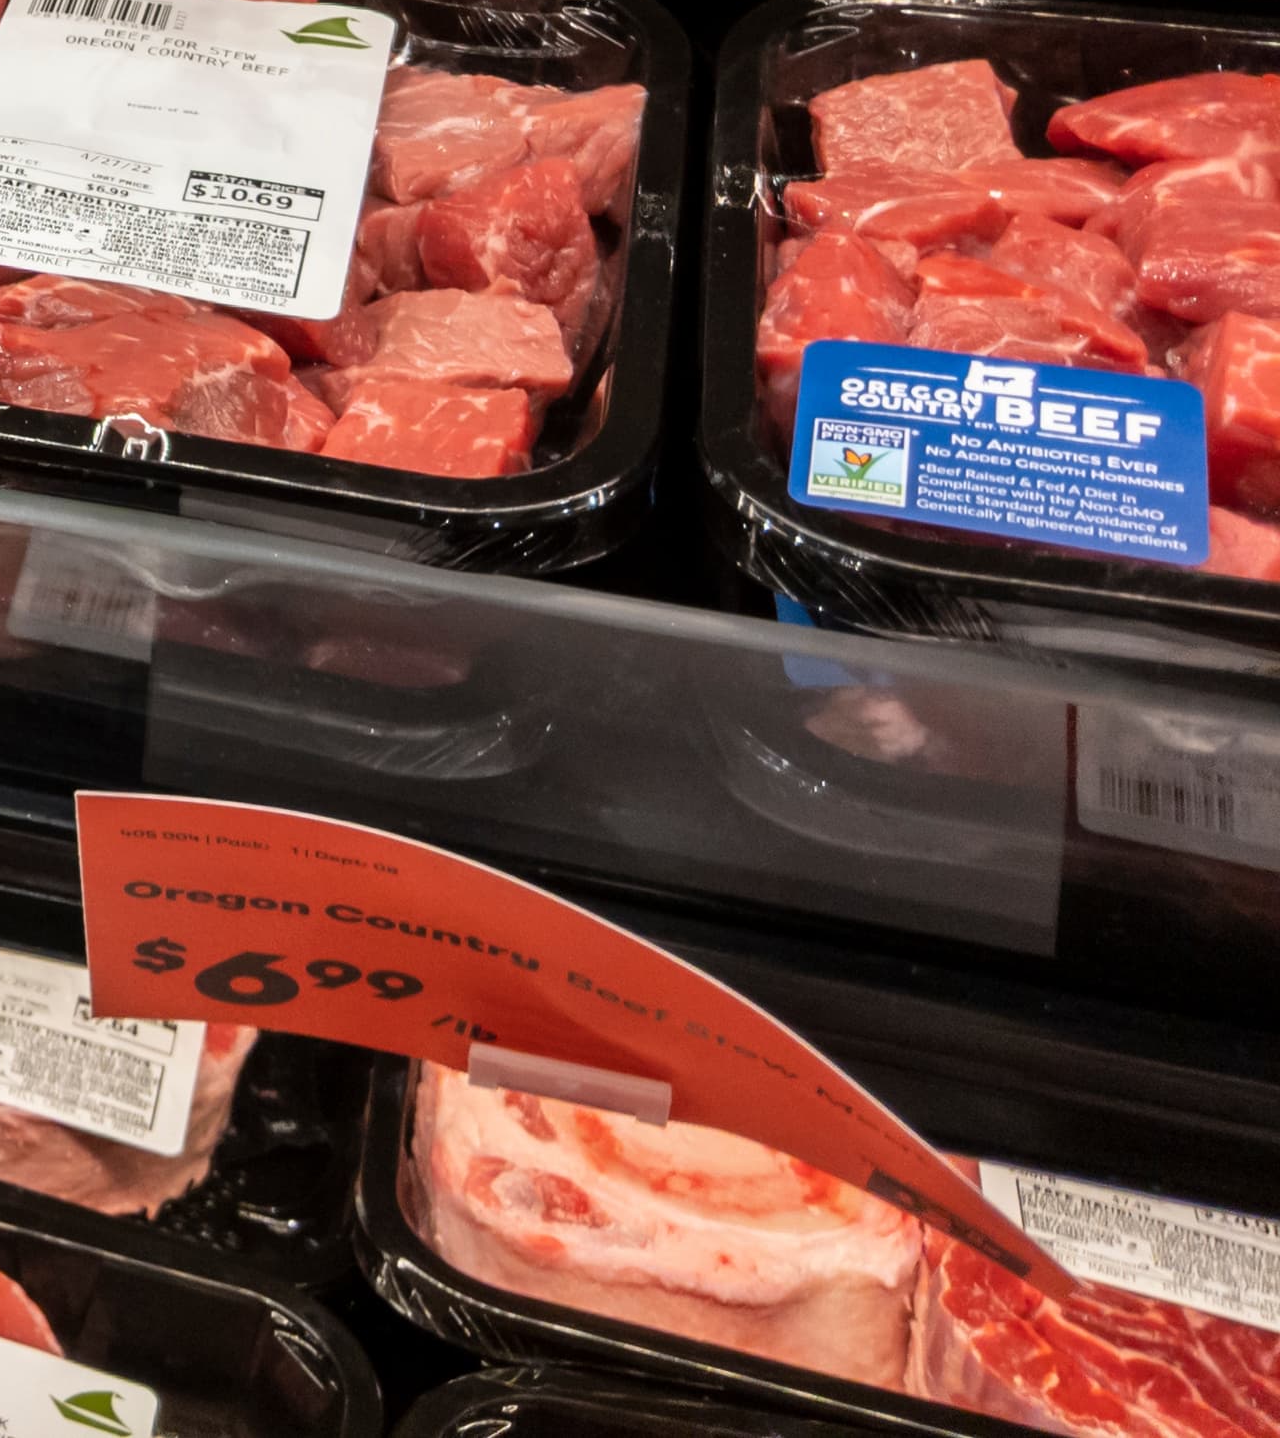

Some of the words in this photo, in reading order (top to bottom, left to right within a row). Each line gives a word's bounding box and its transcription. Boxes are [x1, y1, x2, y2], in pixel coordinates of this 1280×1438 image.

[65, 35, 136, 52] OREGON
[147, 46, 230, 68] COUNTRY
[241, 63, 290, 76] BEEF
[104, 28, 152, 42] BEEF
[163, 37, 198, 50] FOR
[209, 46, 257, 61] STEW
[80, 153, 152, 175] 4/27/22
[44, 185, 141, 213] HANDLING
[86, 183, 129, 198] $6.99
[190, 181, 294, 210] $10.69
[207, 174, 257, 188] TOTAL
[261, 180, 307, 195] PRICE
[16, 251, 72, 268] MARKET
[99, 264, 137, 278] MILL
[146, 271, 200, 292] CREEK,
[211, 286, 231, 297] WA
[240, 291, 288, 307] 98012
[840, 377, 984, 407] OREGON
[822, 423, 903, 439] NON-GMO
[840, 392, 982, 421] COUNTRY
[995, 395, 1162, 444] BEEF
[974, 421, 997, 432] EST.
[821, 431, 901, 447] PROJECT
[816, 475, 898, 493] VERIFIED
[917, 473, 1008, 497] Compliance
[1011, 488, 1046, 502] with
[1049, 494, 1076, 507] the
[1079, 497, 1164, 522] Non-GMO
[965, 468, 1016, 486] Raised
[1019, 477, 1032, 488] &
[1036, 479, 1066, 493] Fed
[1068, 484, 1081, 496] A
[1084, 486, 1118, 502] Diet
[1122, 493, 1137, 504] in
[915, 497, 1002, 522] Genetically
[1006, 513, 1094, 537] Engineered
[1098, 528, 1188, 552] Ingredients
[917, 486, 972, 504] Project
[975, 493, 1045, 514] Standard
[1048, 504, 1071, 519] for
[1073, 509, 1156, 533] Avoidance
[1161, 523, 1178, 537] of
[123, 880, 311, 917] Oregon
[324, 902, 541, 973] Country
[565, 969, 672, 1022] Beef
[683, 1017, 800, 1081] Stew
[430, 1013, 500, 1044] /lb
